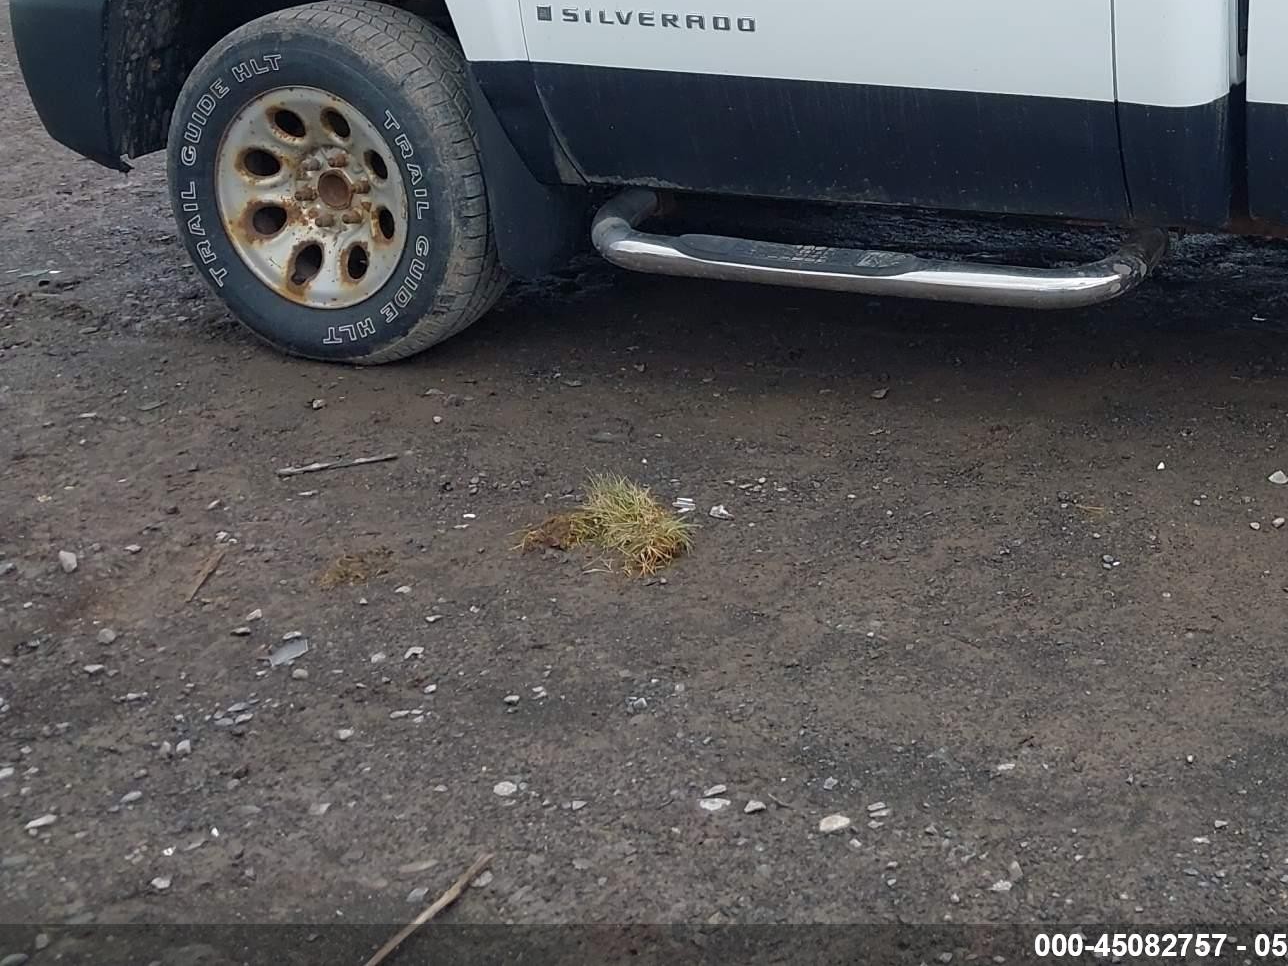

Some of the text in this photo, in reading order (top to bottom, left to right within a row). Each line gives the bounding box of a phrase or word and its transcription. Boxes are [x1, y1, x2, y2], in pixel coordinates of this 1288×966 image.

[562, 7, 756, 33] SILVERADO
[181, 54, 282, 287] TRAIL GUIDE HLT
[323, 110, 431, 345] TRAIL GUIDE HLT
